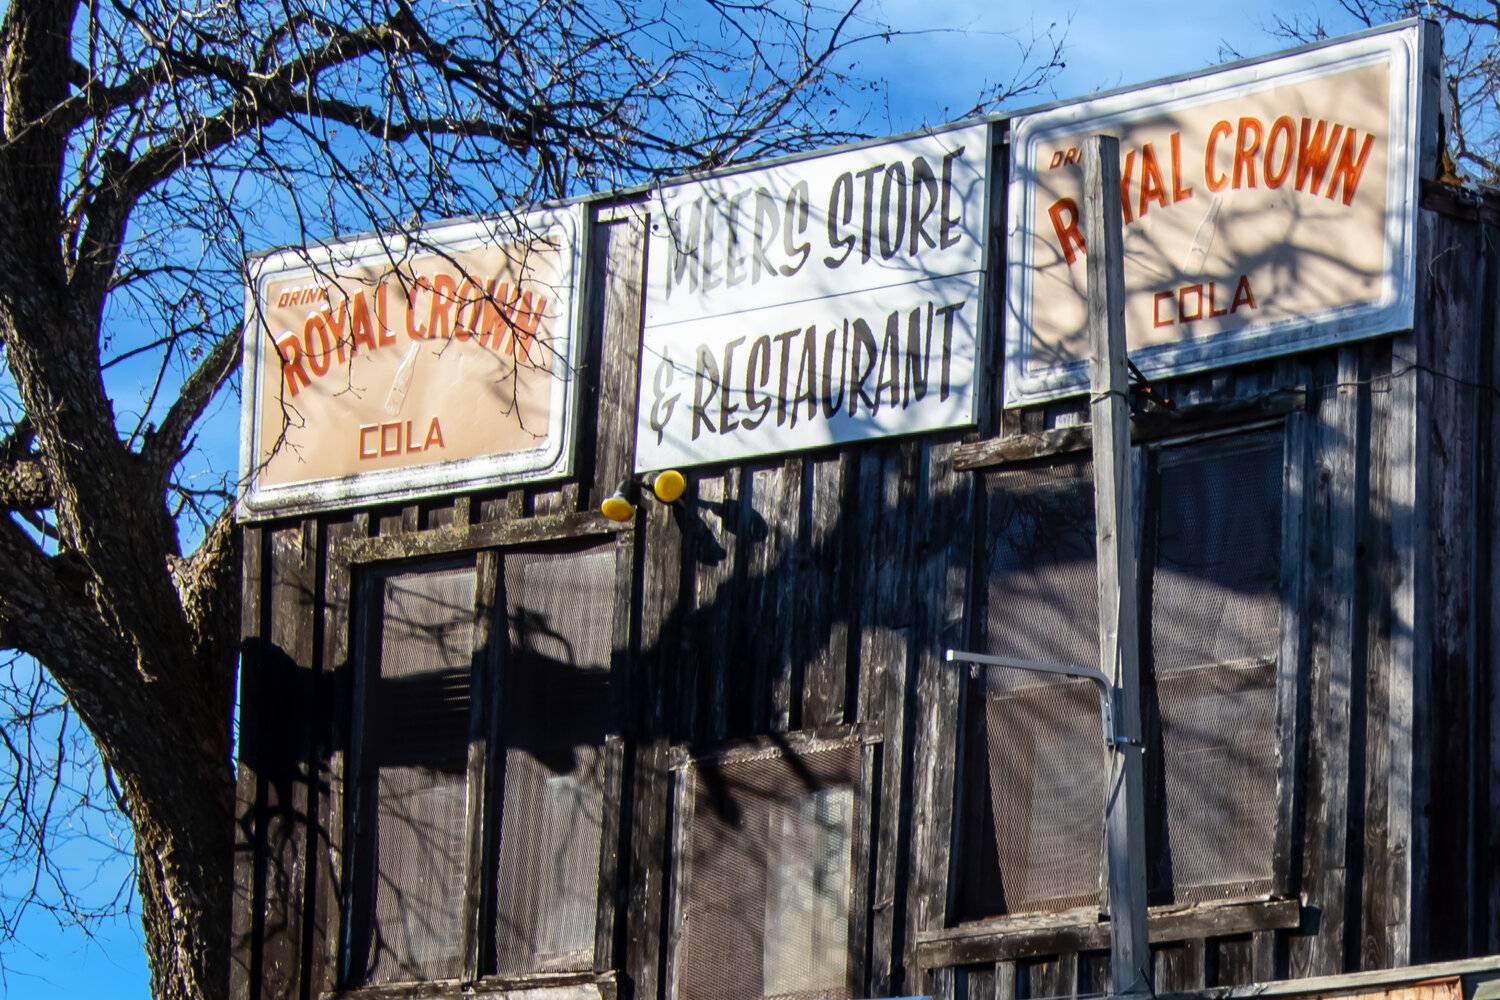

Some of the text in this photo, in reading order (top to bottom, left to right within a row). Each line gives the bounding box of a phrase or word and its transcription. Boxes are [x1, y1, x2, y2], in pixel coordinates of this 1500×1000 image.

[1047, 114, 1376, 267] RYAL CROWN
[1048, 147, 1082, 170] DRI
[665, 146, 966, 302] MEERS STORE
[275, 273, 548, 398] ROYAL CROWN
[1153, 275, 1258, 329] COLA
[650, 301, 966, 447] & RESTAURANT
[358, 416, 446, 461] COLA
